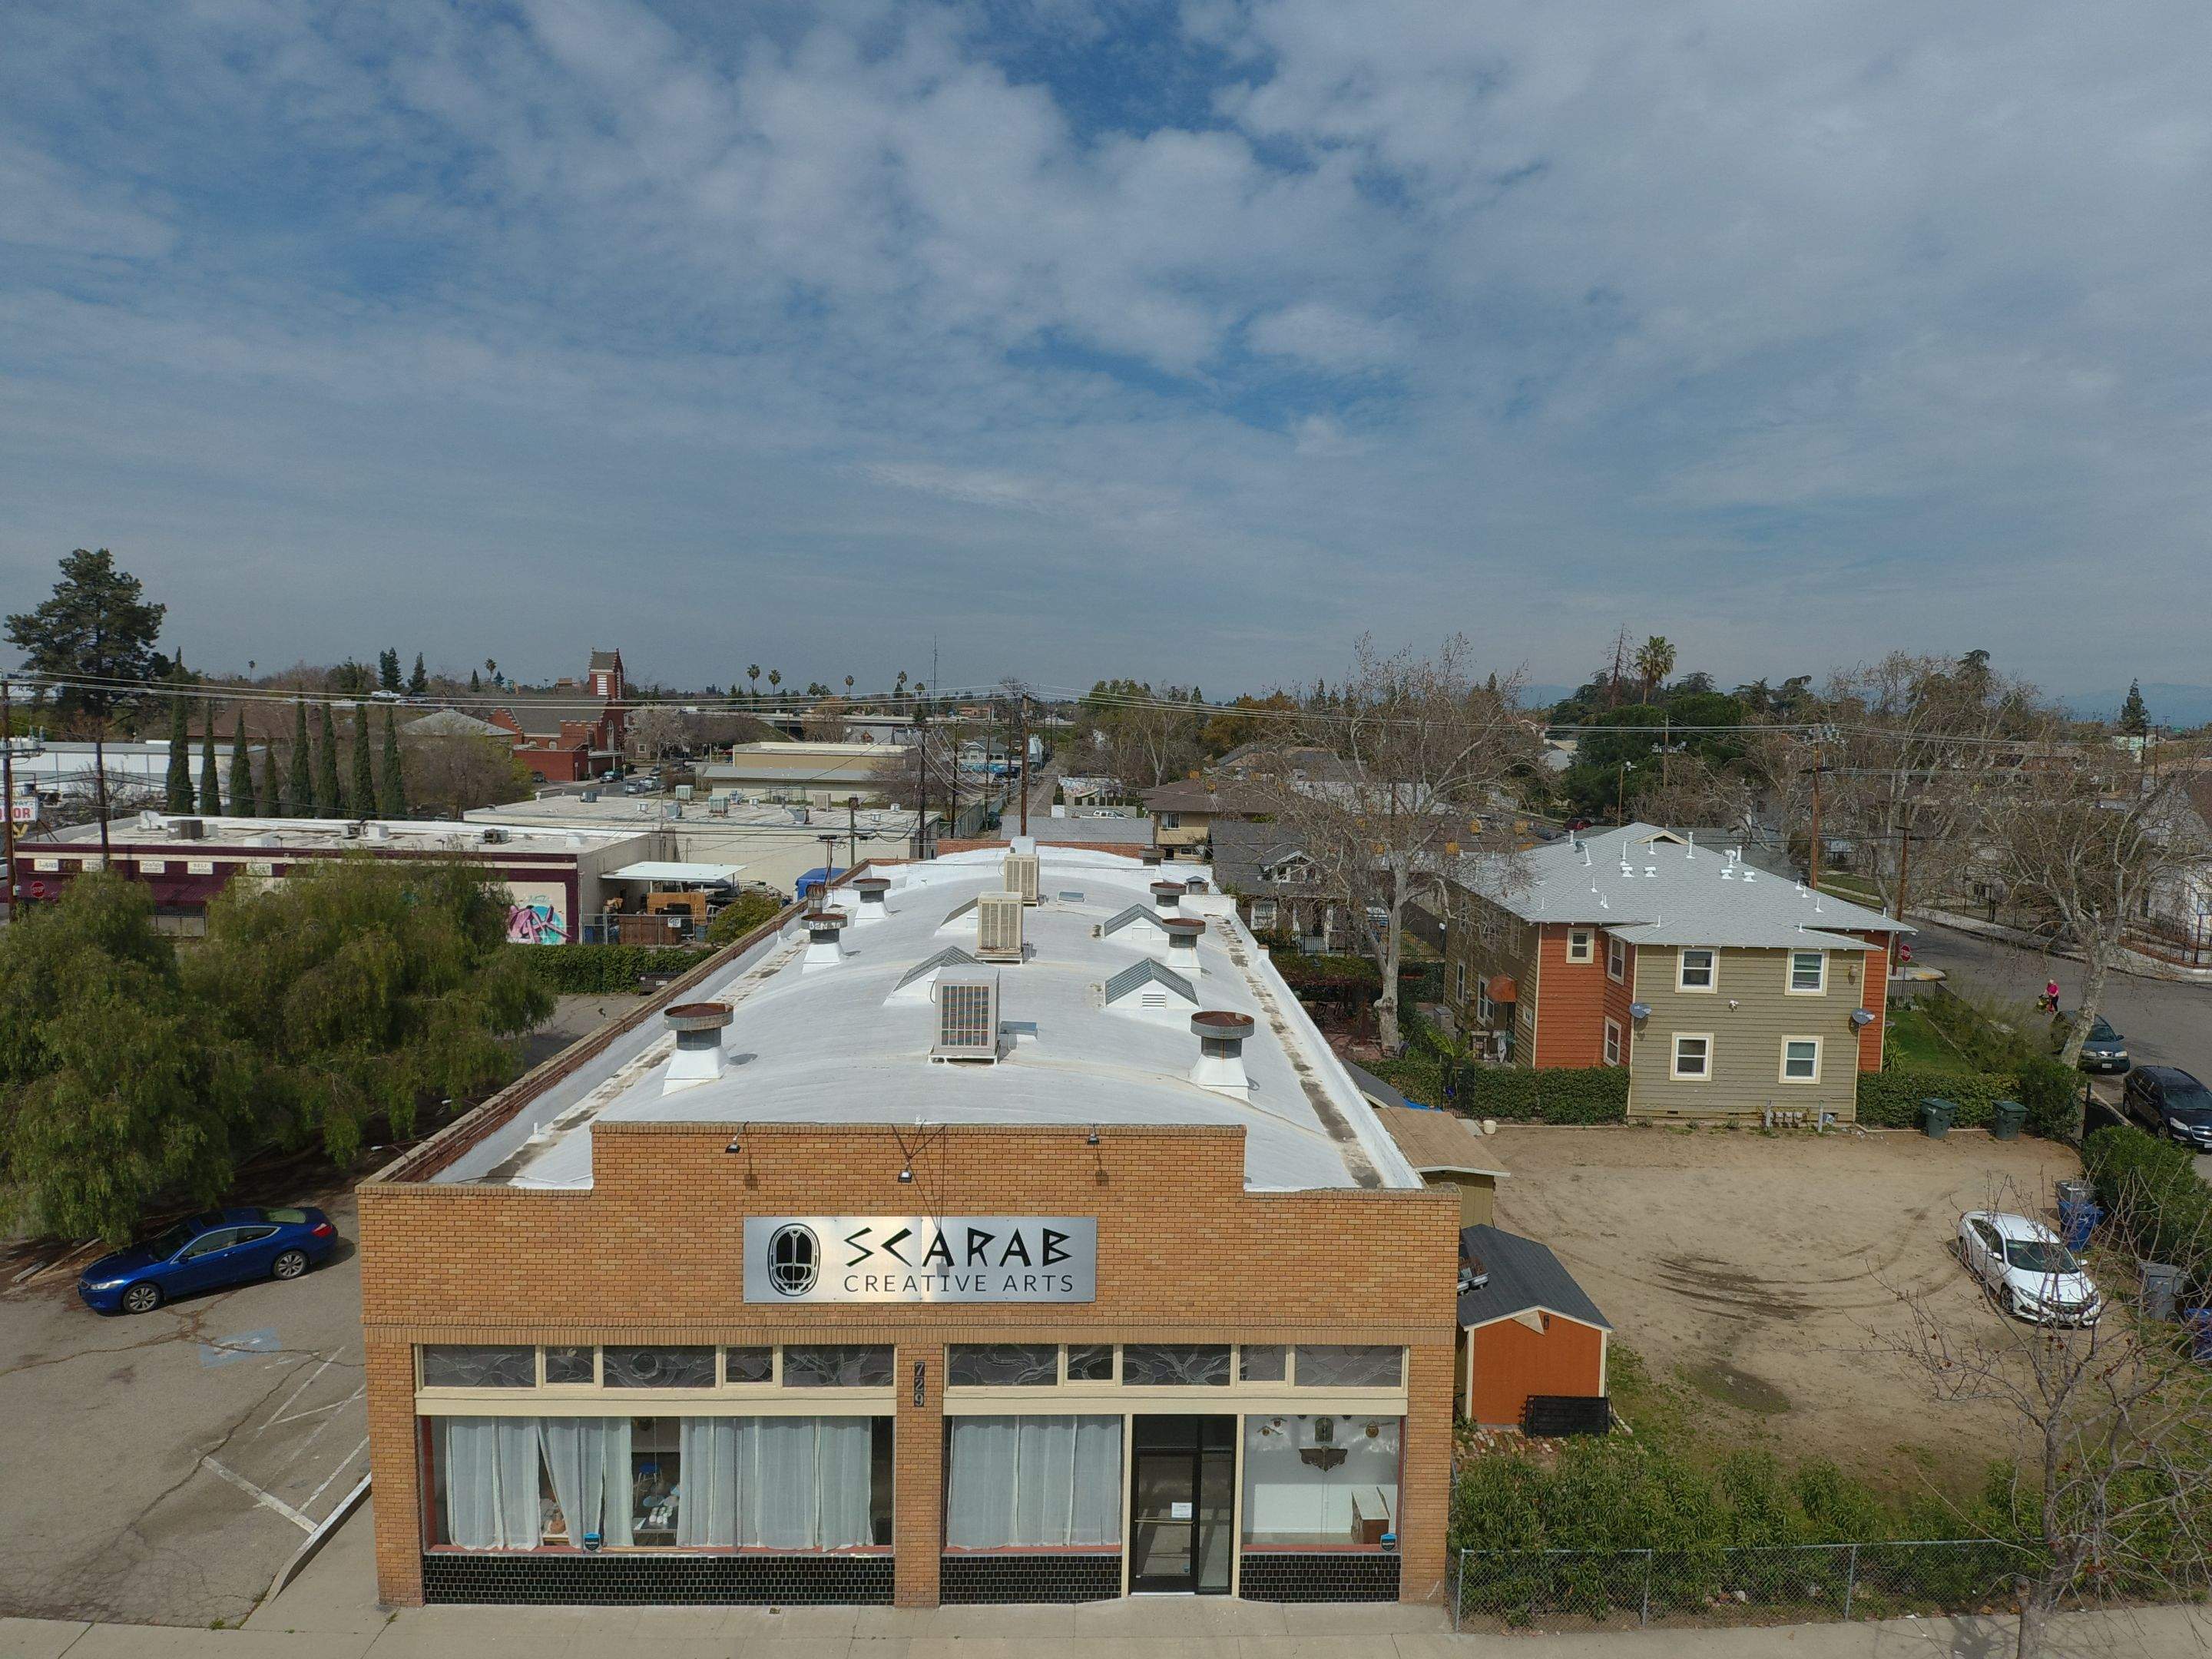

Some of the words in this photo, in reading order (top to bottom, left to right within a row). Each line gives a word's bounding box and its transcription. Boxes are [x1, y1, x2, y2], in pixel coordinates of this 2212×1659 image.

[843, 1227, 1074, 1267] SCARAB
[843, 1274, 987, 1293] CREATIVE
[1002, 1274, 1074, 1292] ARTS
[914, 1363, 925, 1407] 729
